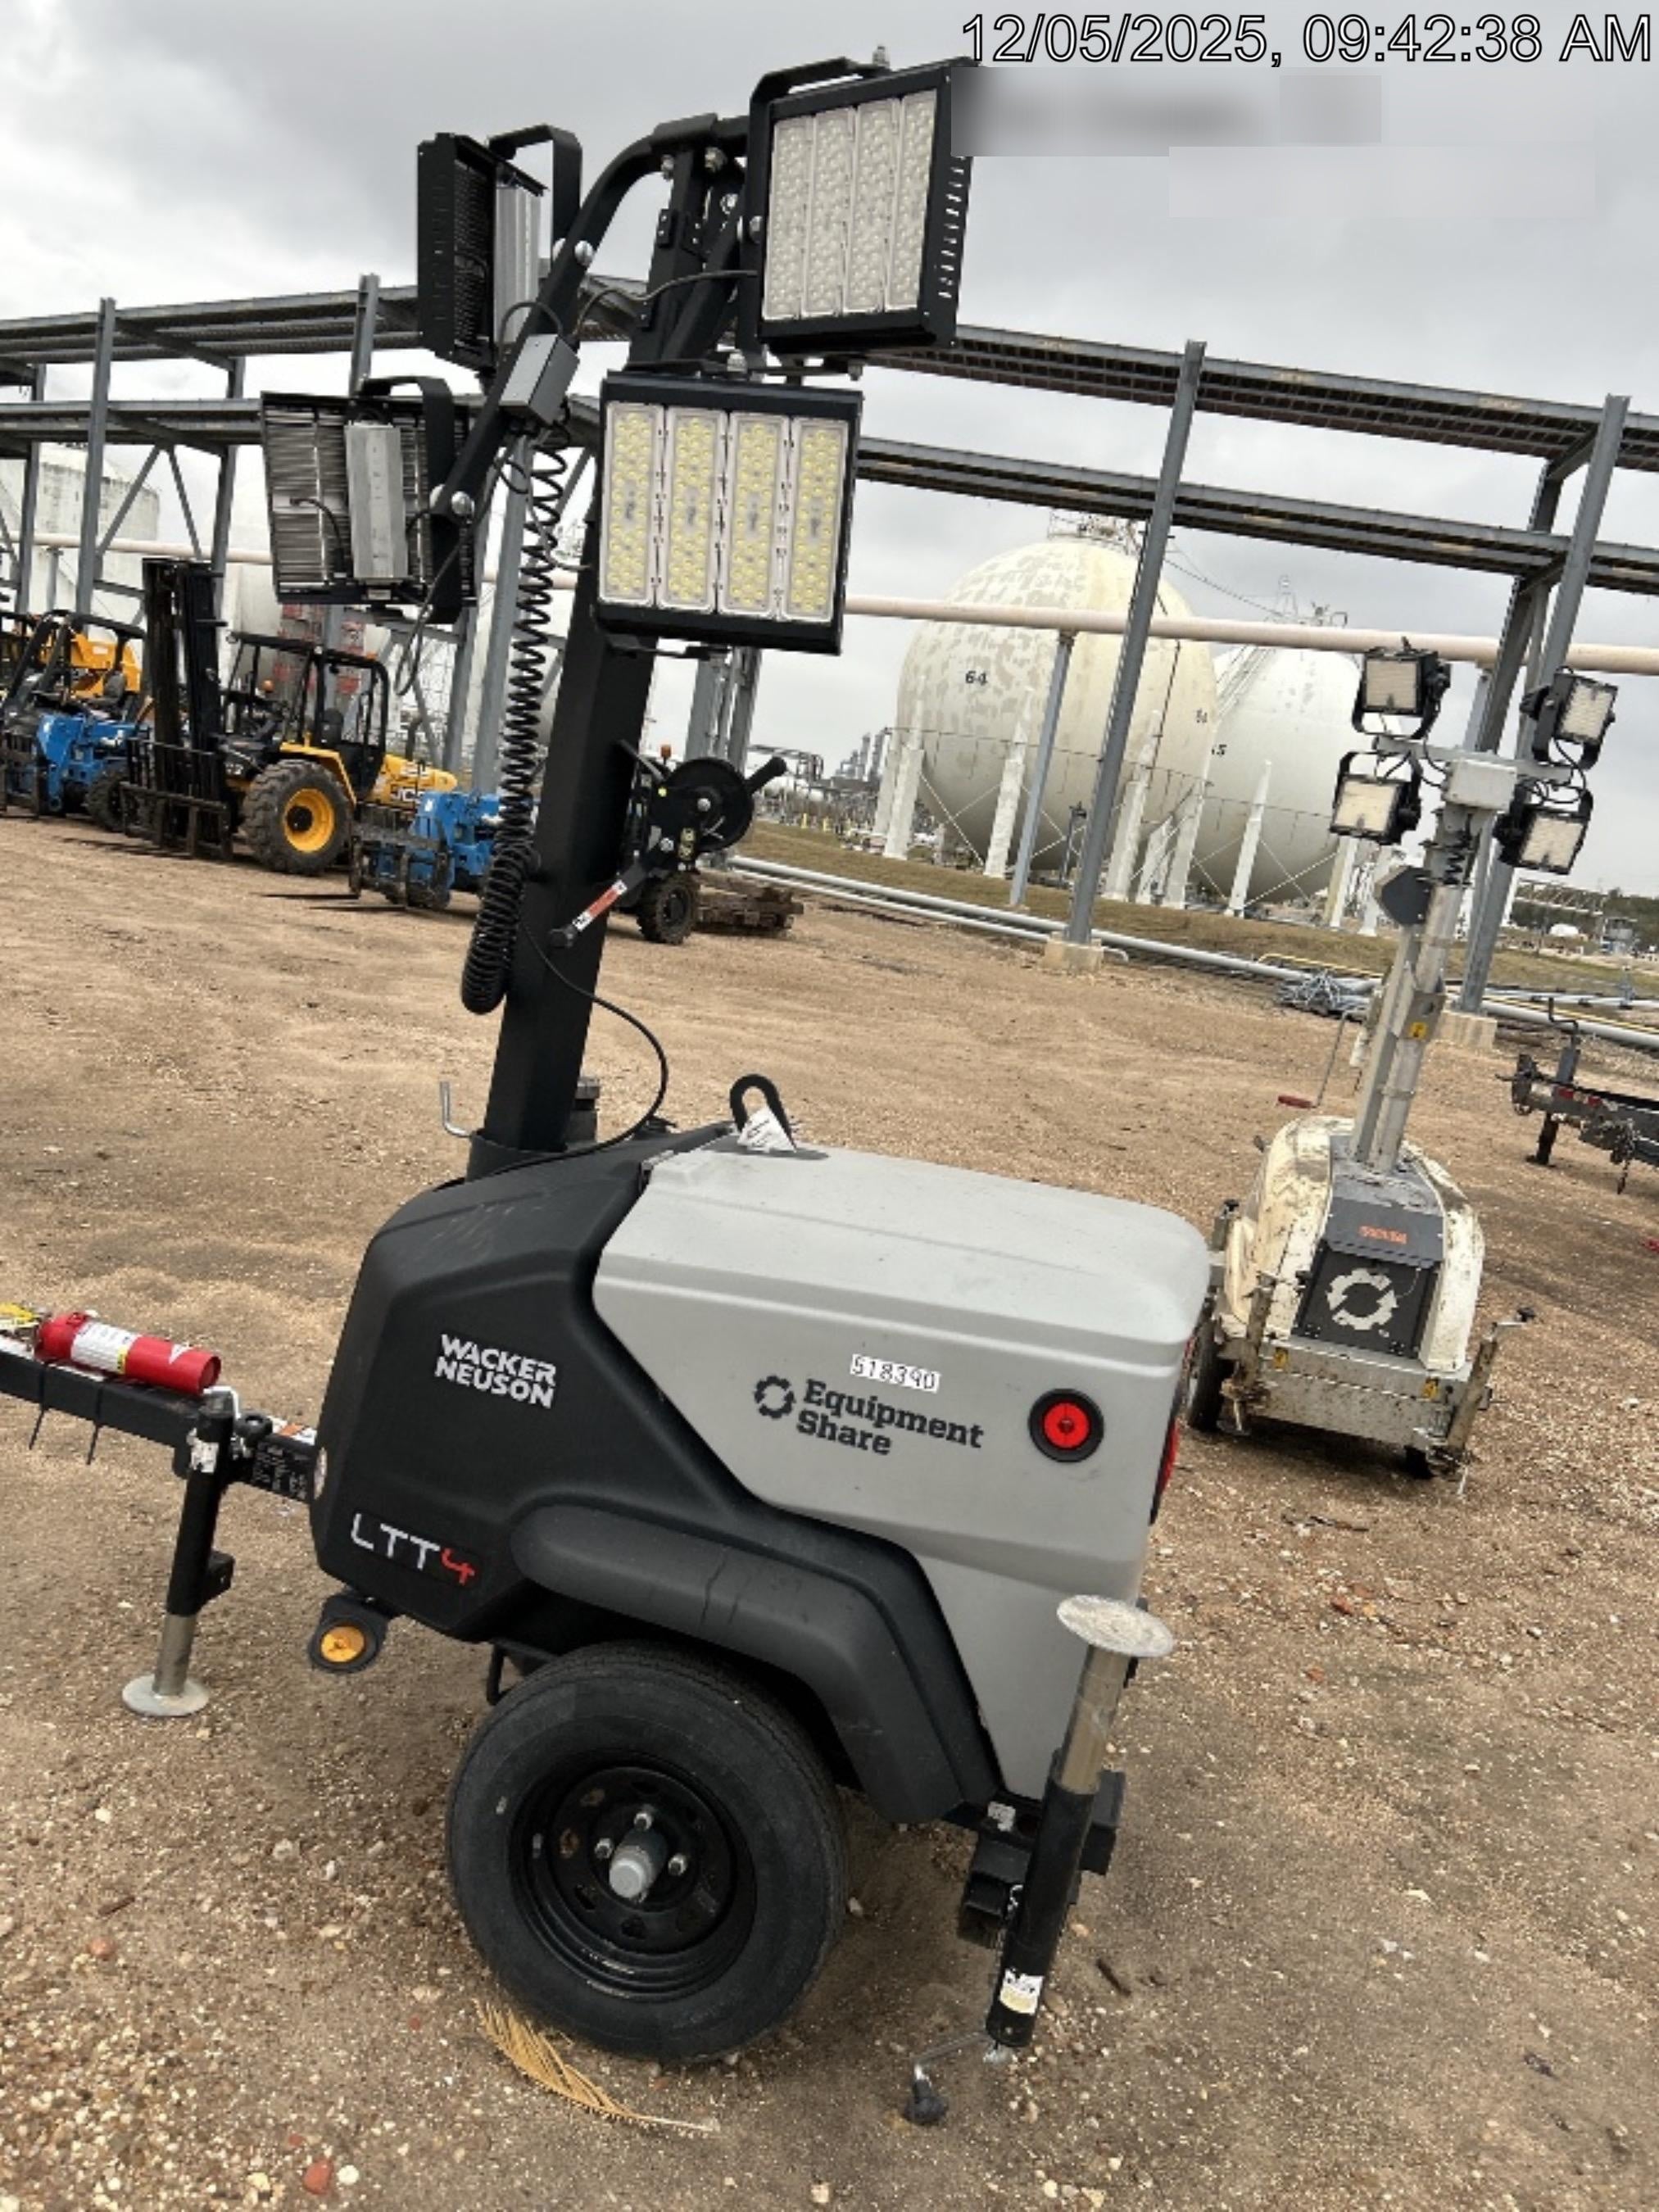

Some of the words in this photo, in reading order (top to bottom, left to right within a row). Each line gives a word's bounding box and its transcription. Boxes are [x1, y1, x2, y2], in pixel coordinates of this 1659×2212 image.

[434, 1356, 555, 1409] NEUSON
[441, 1333, 556, 1386] WACKER
[851, 1355, 936, 1390] 518390
[796, 1408, 891, 1456] Share
[803, 1378, 984, 1448] Equipment
[350, 1512, 475, 1586] LTT4
